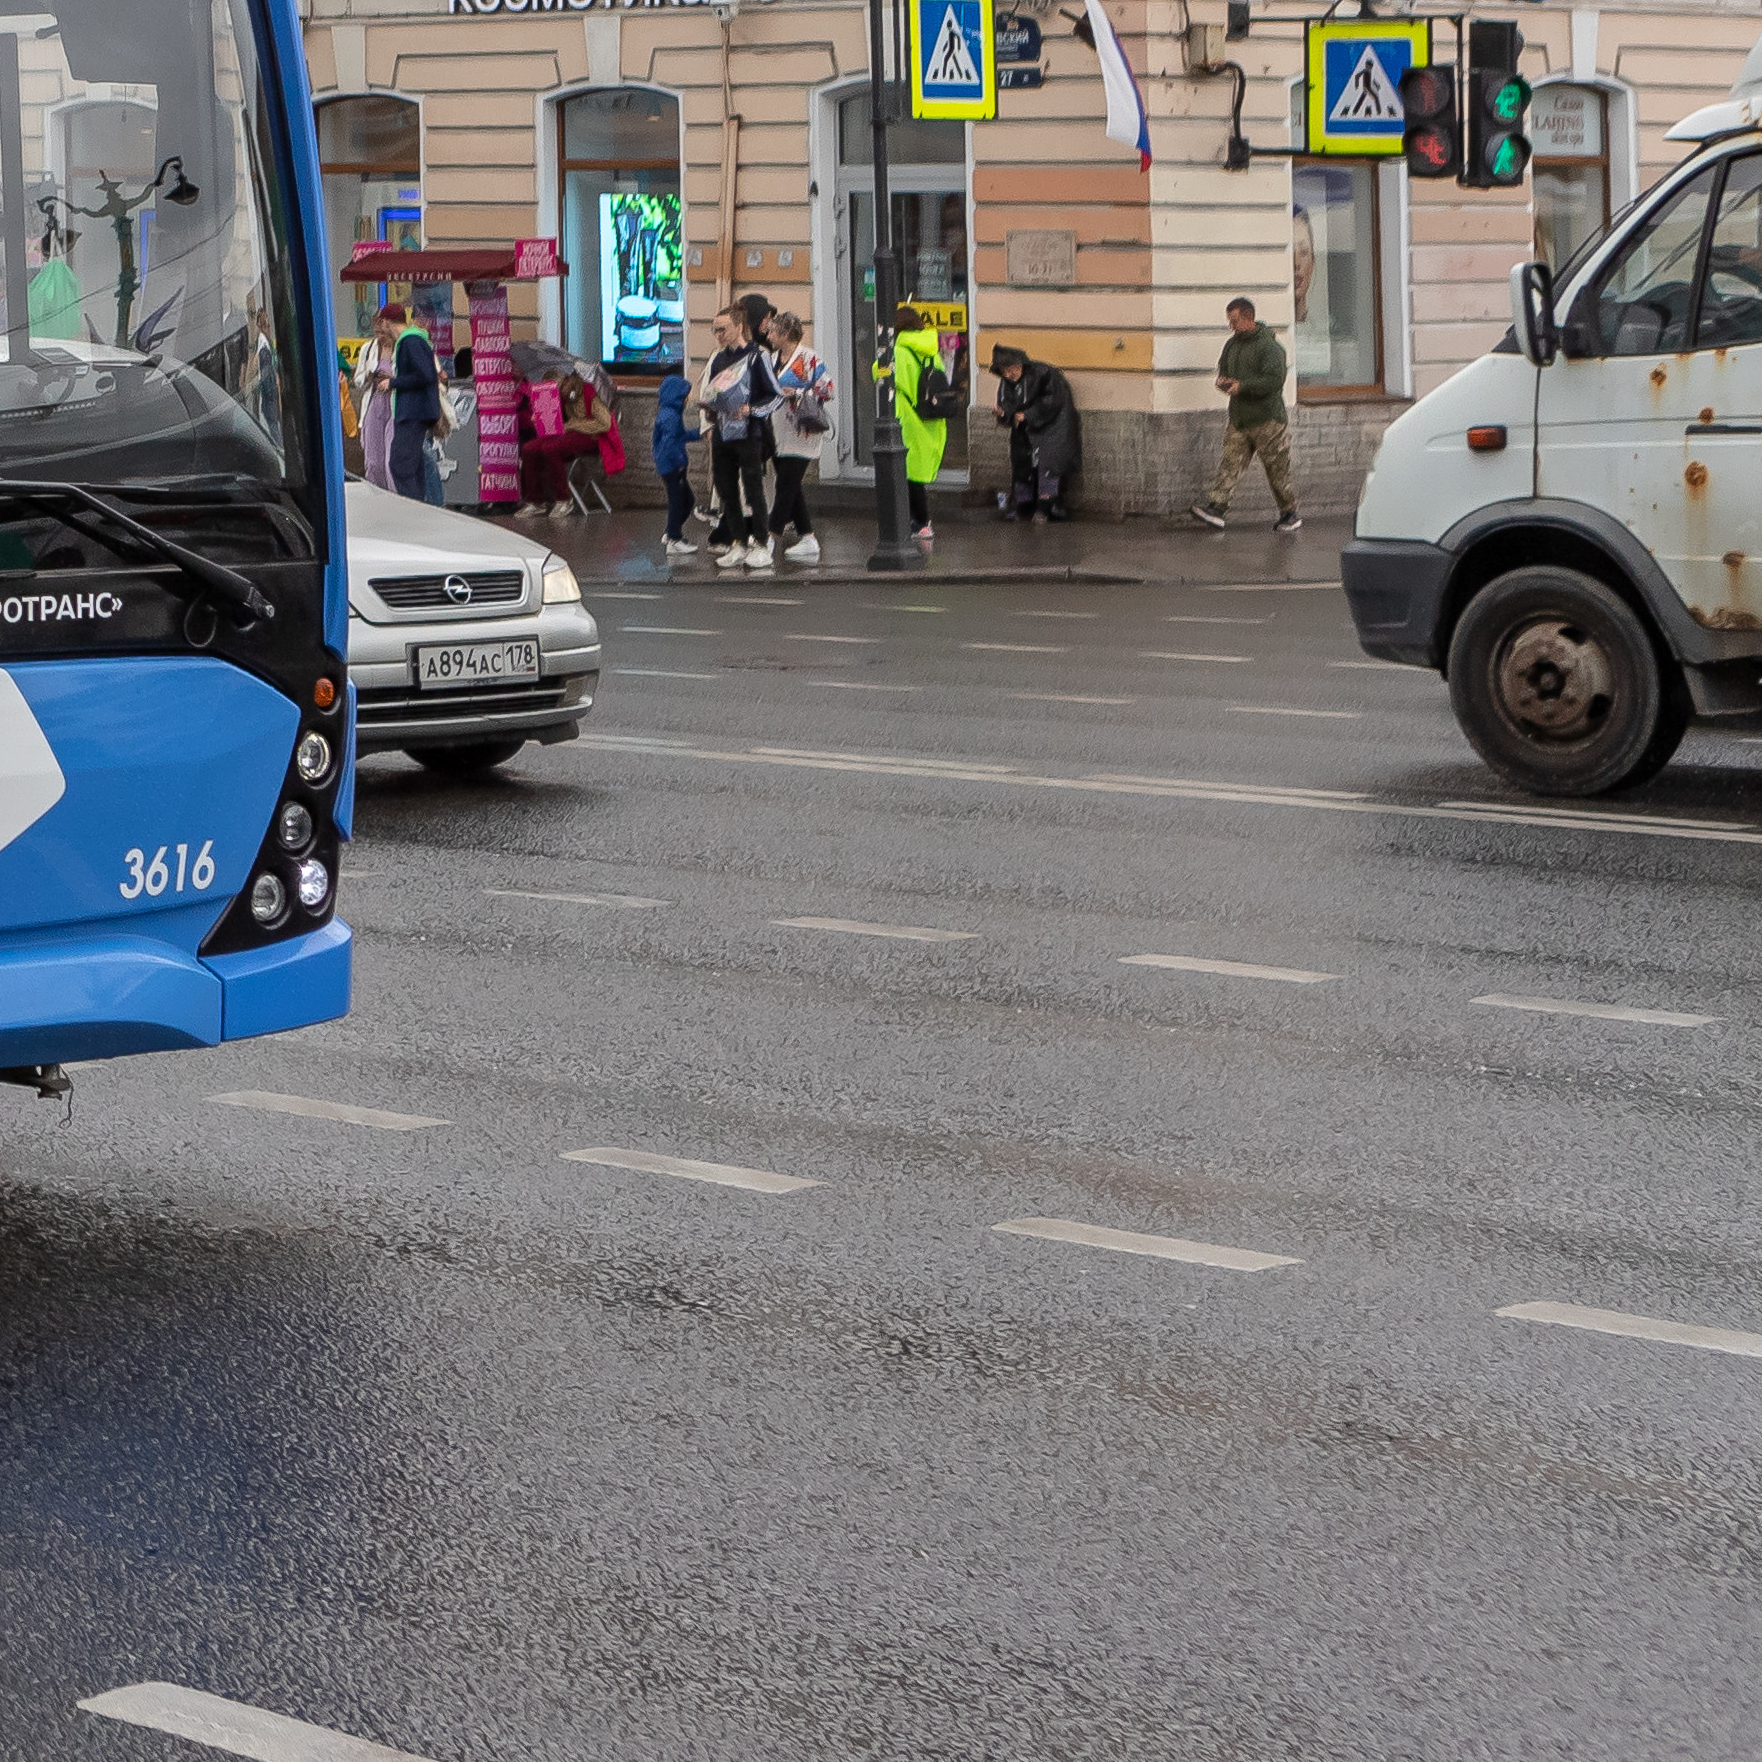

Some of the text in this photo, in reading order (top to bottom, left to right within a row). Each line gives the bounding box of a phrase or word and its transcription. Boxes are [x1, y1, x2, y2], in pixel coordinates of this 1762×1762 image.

[921, 311, 963, 327] ALE
[426, 644, 534, 678] А894АС 178
[119, 838, 216, 900] 3616
